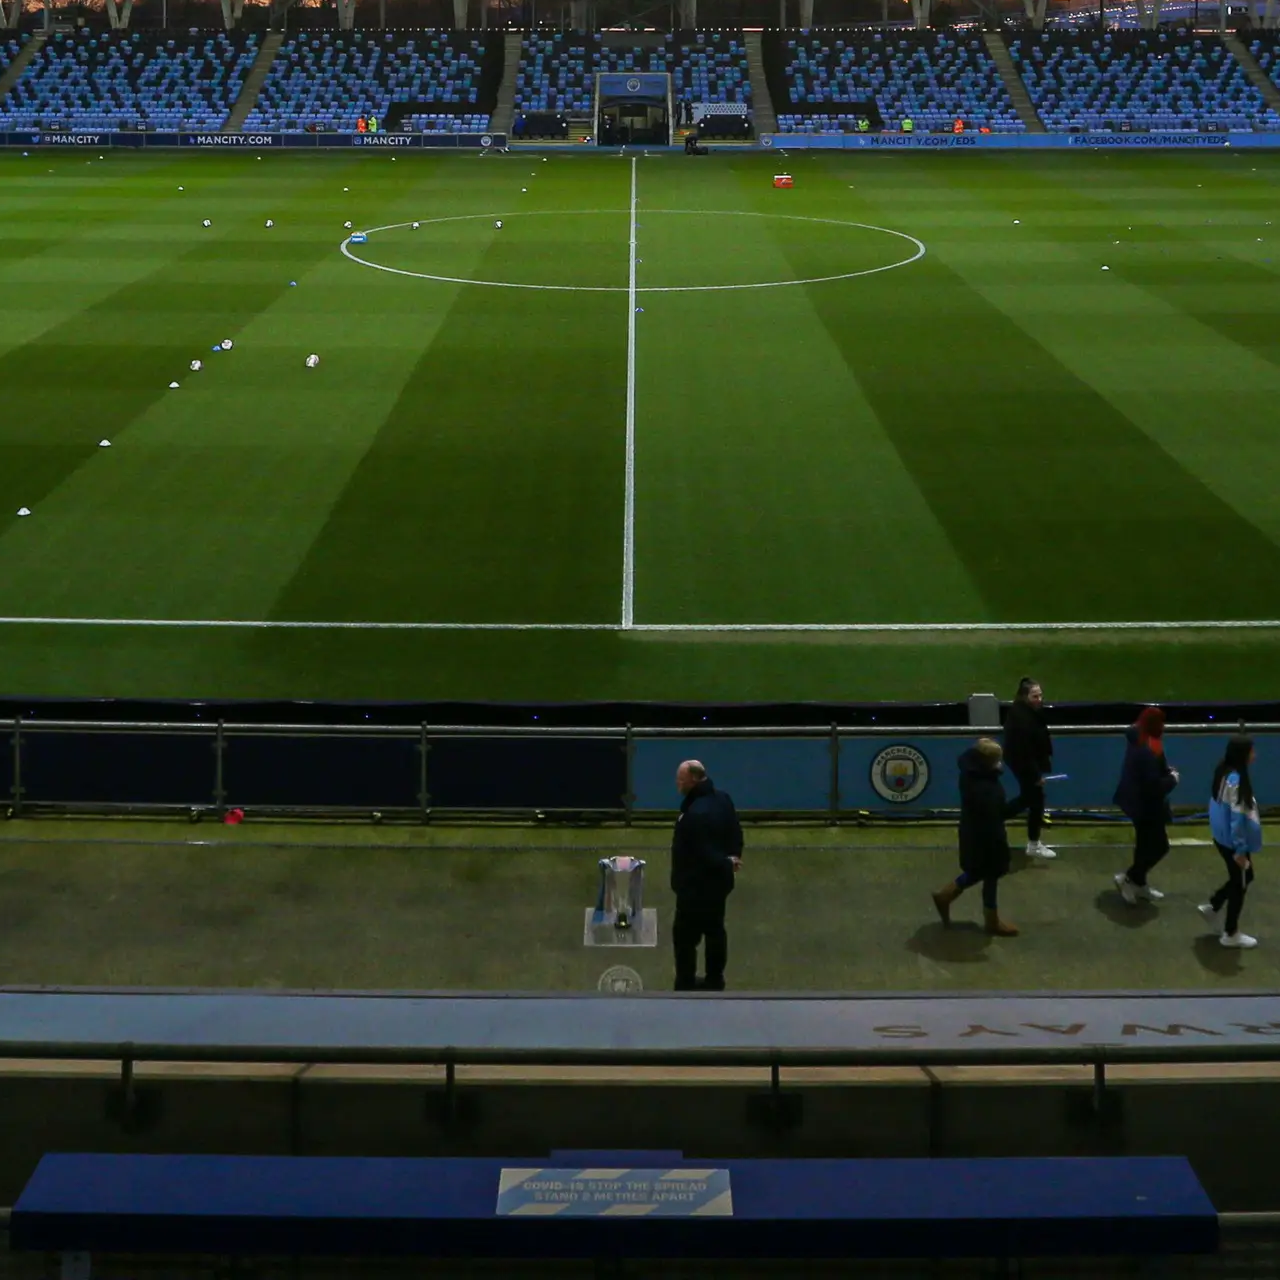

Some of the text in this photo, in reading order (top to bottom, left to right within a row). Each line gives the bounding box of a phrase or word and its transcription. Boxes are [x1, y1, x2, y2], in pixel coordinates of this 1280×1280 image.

[197, 135, 272, 145] MANCITY.COM
[363, 136, 412, 145] MANCITY
[870, 136, 976, 146] MANCITY.COM/EDS
[589, 1181, 621, 1190] STOP
[626, 1181, 649, 1190] THE
[654, 1182, 707, 1191] SPREAD
[534, 1192, 696, 1201] STAND 2 METRES APART
